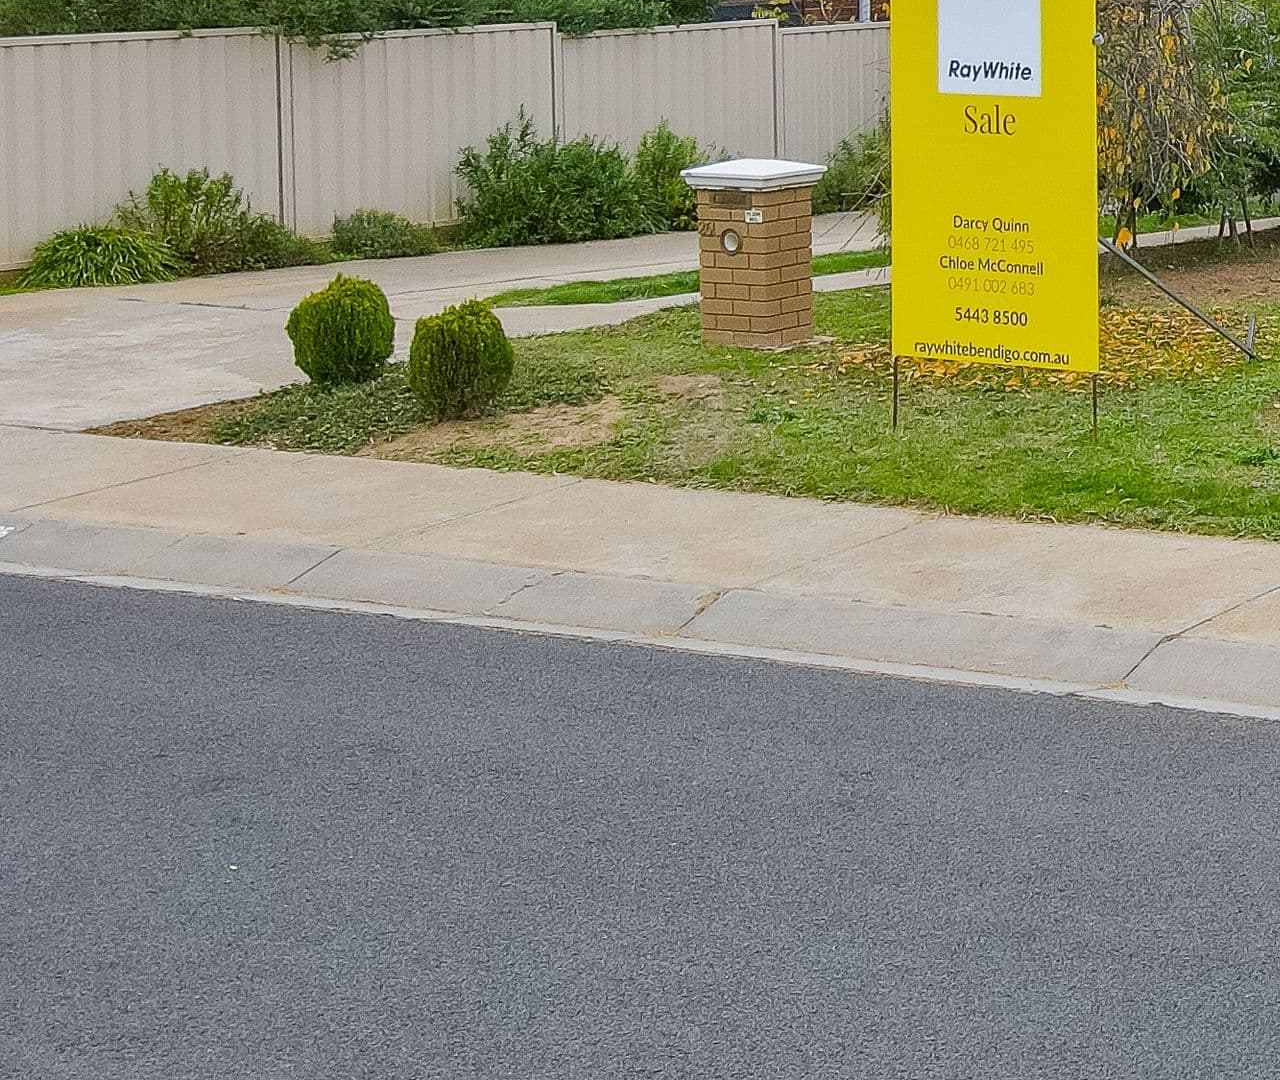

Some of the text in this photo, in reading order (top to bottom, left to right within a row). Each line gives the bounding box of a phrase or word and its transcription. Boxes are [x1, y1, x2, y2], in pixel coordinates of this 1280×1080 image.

[949, 60, 1033, 81] RayWhite
[964, 104, 1016, 135] Sale
[953, 215, 1029, 233] Darcy Quinn
[948, 235, 1034, 254] 0468 721 495
[940, 255, 1043, 275] Chloe McConnell
[948, 276, 979, 291] 0491
[983, 279, 1006, 293] 002
[955, 307, 1028, 326] 5443 8500
[914, 340, 1070, 365] raywhitebendigo.com.au
